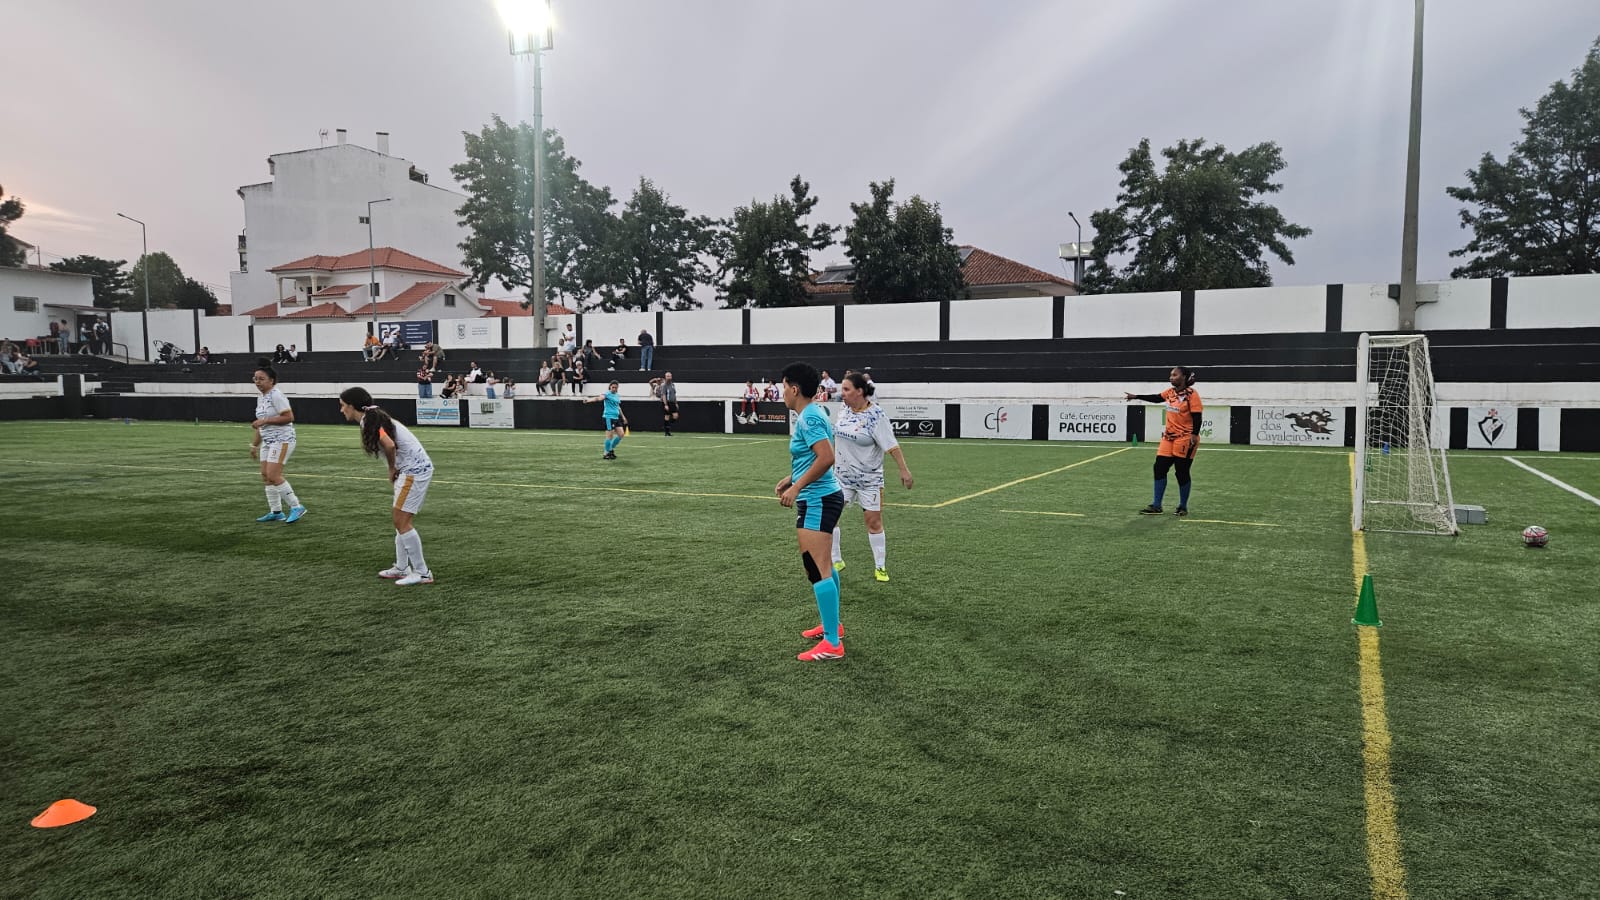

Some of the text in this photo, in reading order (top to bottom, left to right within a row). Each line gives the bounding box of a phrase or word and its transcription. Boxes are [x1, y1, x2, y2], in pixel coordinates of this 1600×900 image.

[1059, 412, 1116, 422] Café, Cervejaria
[1257, 409, 1285, 420] Hotel
[1059, 422, 1117, 434] PACHECO
[1260, 420, 1282, 431] dos
[1256, 430, 1313, 441] Cavaleiros
[872, 493, 877, 502] 7
